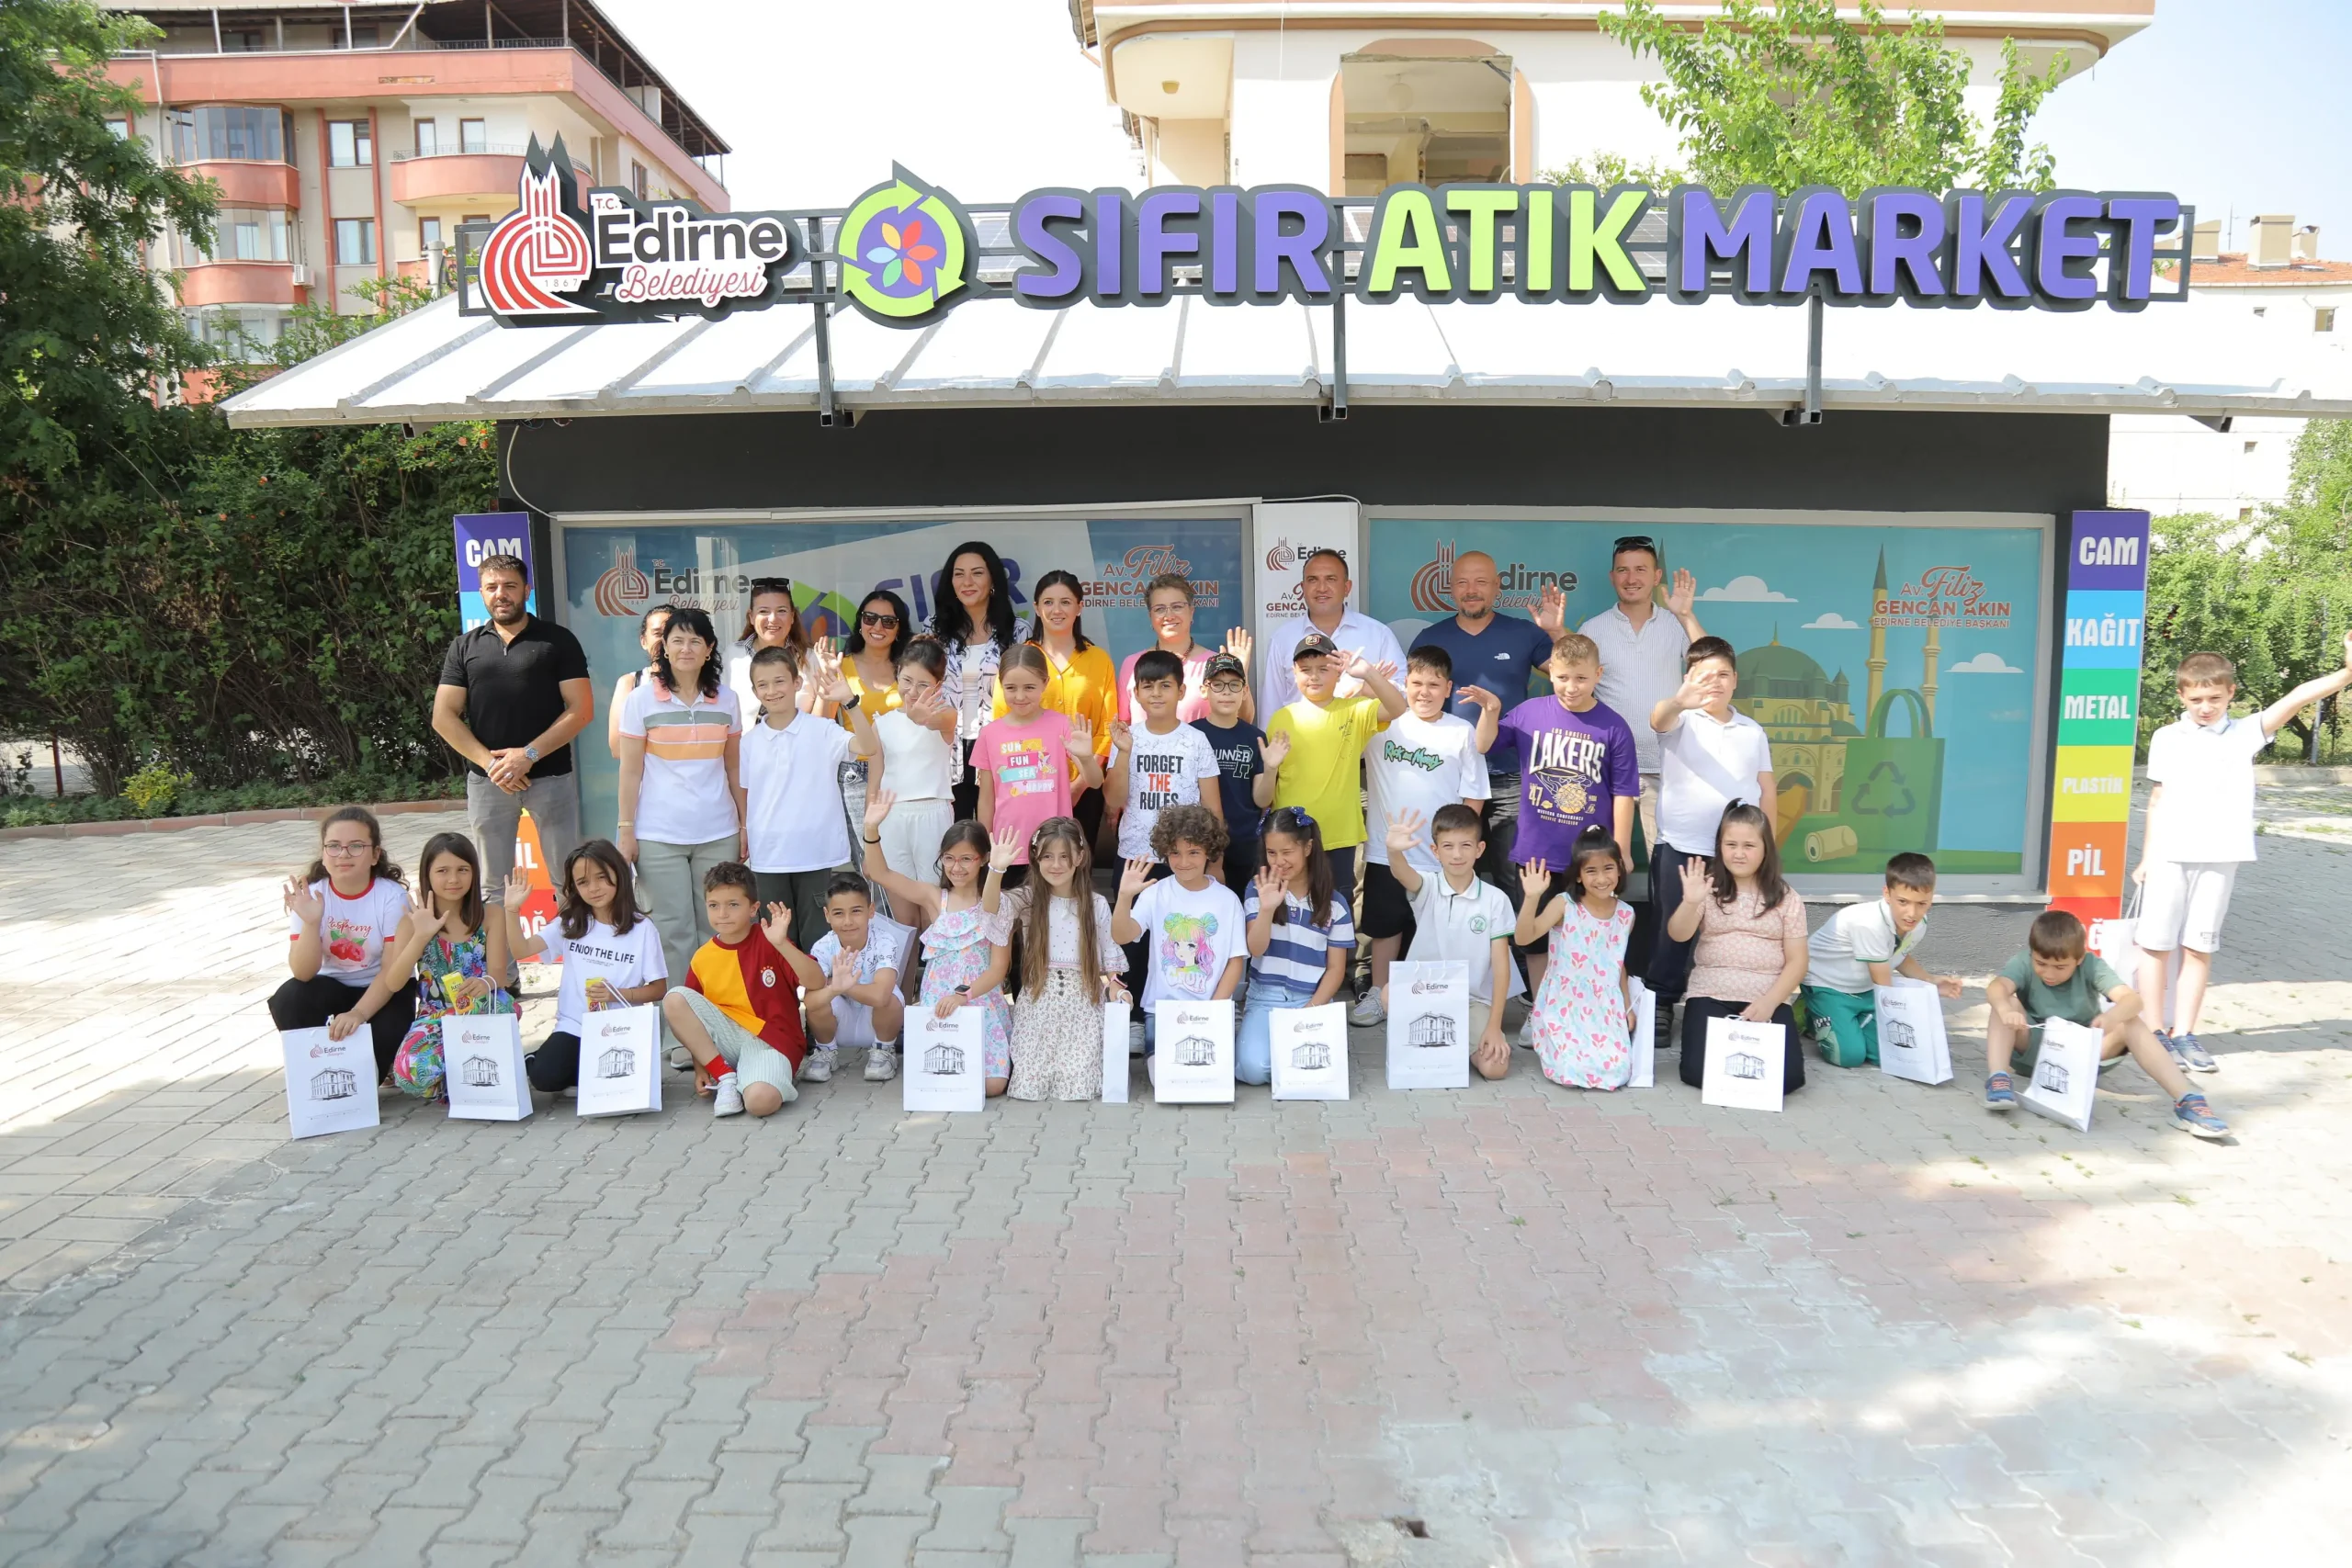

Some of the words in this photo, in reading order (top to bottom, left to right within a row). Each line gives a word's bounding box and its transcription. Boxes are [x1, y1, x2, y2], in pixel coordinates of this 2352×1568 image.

[594, 197, 617, 209] T.C.
[600, 210, 784, 263] Edirne
[1017, 191, 1331, 298] SIFIR
[1368, 190, 1647, 292] ATIK
[1681, 191, 2179, 300] MARKET
[545, 278, 578, 287] 1867
[619, 265, 763, 306] Belediyesi
[1103, 563, 1127, 577] Av.
[1124, 544, 1193, 579] Filiz
[2079, 536, 2139, 566] CAM
[654, 568, 750, 594] Edirne
[1498, 563, 1578, 591] dirne
[1900, 582, 1924, 596] Av.
[1921, 565, 1986, 606] Filiz
[1081, 581, 1146, 596] GENCA
[1189, 581, 1219, 595] KIN
[669, 594, 740, 614] Belediyesi
[1119, 599, 1146, 607] BELE
[1194, 598, 1219, 607] KANI
[1266, 603, 1306, 611] GENCA
[1875, 600, 1957, 615] GENCAN
[1963, 602, 2010, 616] AKIN
[1874, 616, 1910, 626] EDİRNE
[1915, 617, 1962, 627] BELEDİYE
[1965, 619, 2009, 629] BAŞKANI
[2065, 613, 2141, 647] KAĞIT
[2064, 695, 2131, 719] METAL
[1001, 741, 1022, 753] SUN
[1214, 749, 1250, 762] UNNER
[1529, 730, 1606, 784] LAKERS
[1011, 754, 1029, 766] FUN
[1136, 754, 1184, 773] FORGET
[1148, 773, 1171, 792] THE
[2062, 774, 2123, 795] PLASTİK
[1529, 784, 1544, 807] 47
[514, 837, 538, 869] İL
[2067, 843, 2106, 876] PİL
[570, 942, 594, 956] ENJOY
[595, 948, 613, 960] THE
[615, 952, 635, 964] LIFE
